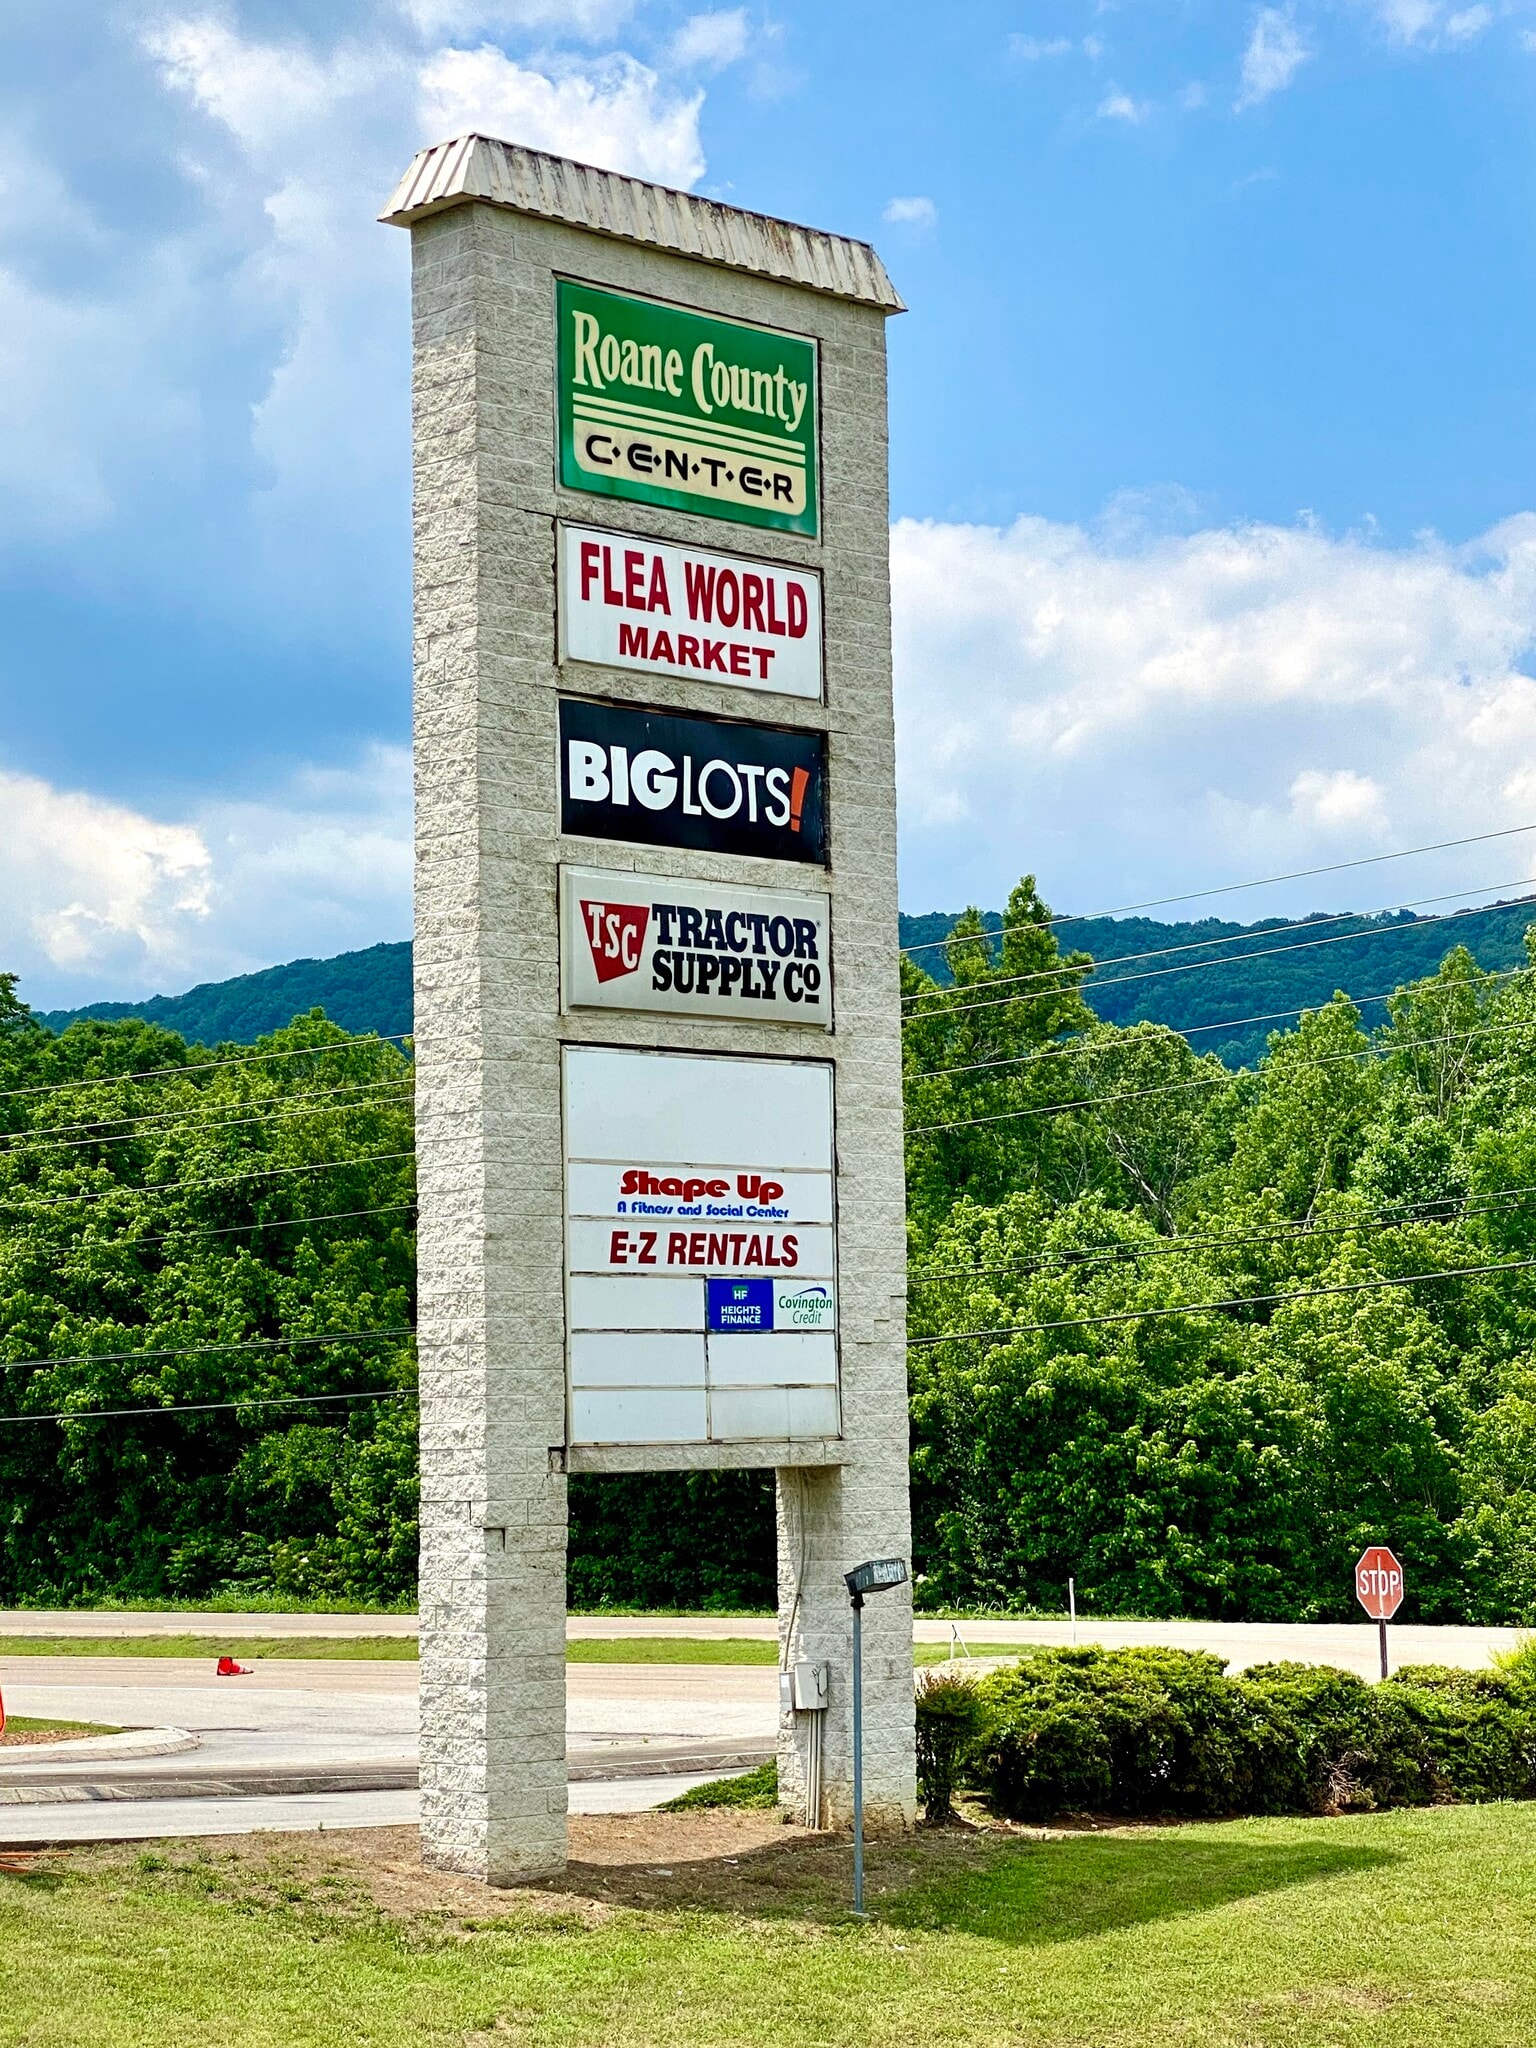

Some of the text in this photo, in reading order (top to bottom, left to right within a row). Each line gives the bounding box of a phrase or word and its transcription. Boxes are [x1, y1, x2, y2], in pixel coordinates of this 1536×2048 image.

[572, 309, 808, 433] Roane County
[580, 541, 808, 639] FLEA WORLD
[619, 623, 775, 680] MARKET
[588, 904, 639, 970] TSC
[652, 903, 819, 961] TRACTOR
[652, 949, 781, 1001] SUPPLY
[620, 1170, 784, 1205] Shape Up
[617, 1201, 789, 1218] A Fitness and Social Center
[610, 1231, 799, 1268] E-Z RENTALS
[721, 1306, 761, 1315] HEIGHTS
[733, 1290, 748, 1300] HF
[779, 1295, 832, 1312] Covington
[721, 1315, 761, 1324] FINANCE
[792, 1310, 822, 1324] Credit
[1359, 1569, 1400, 1596] STOP
